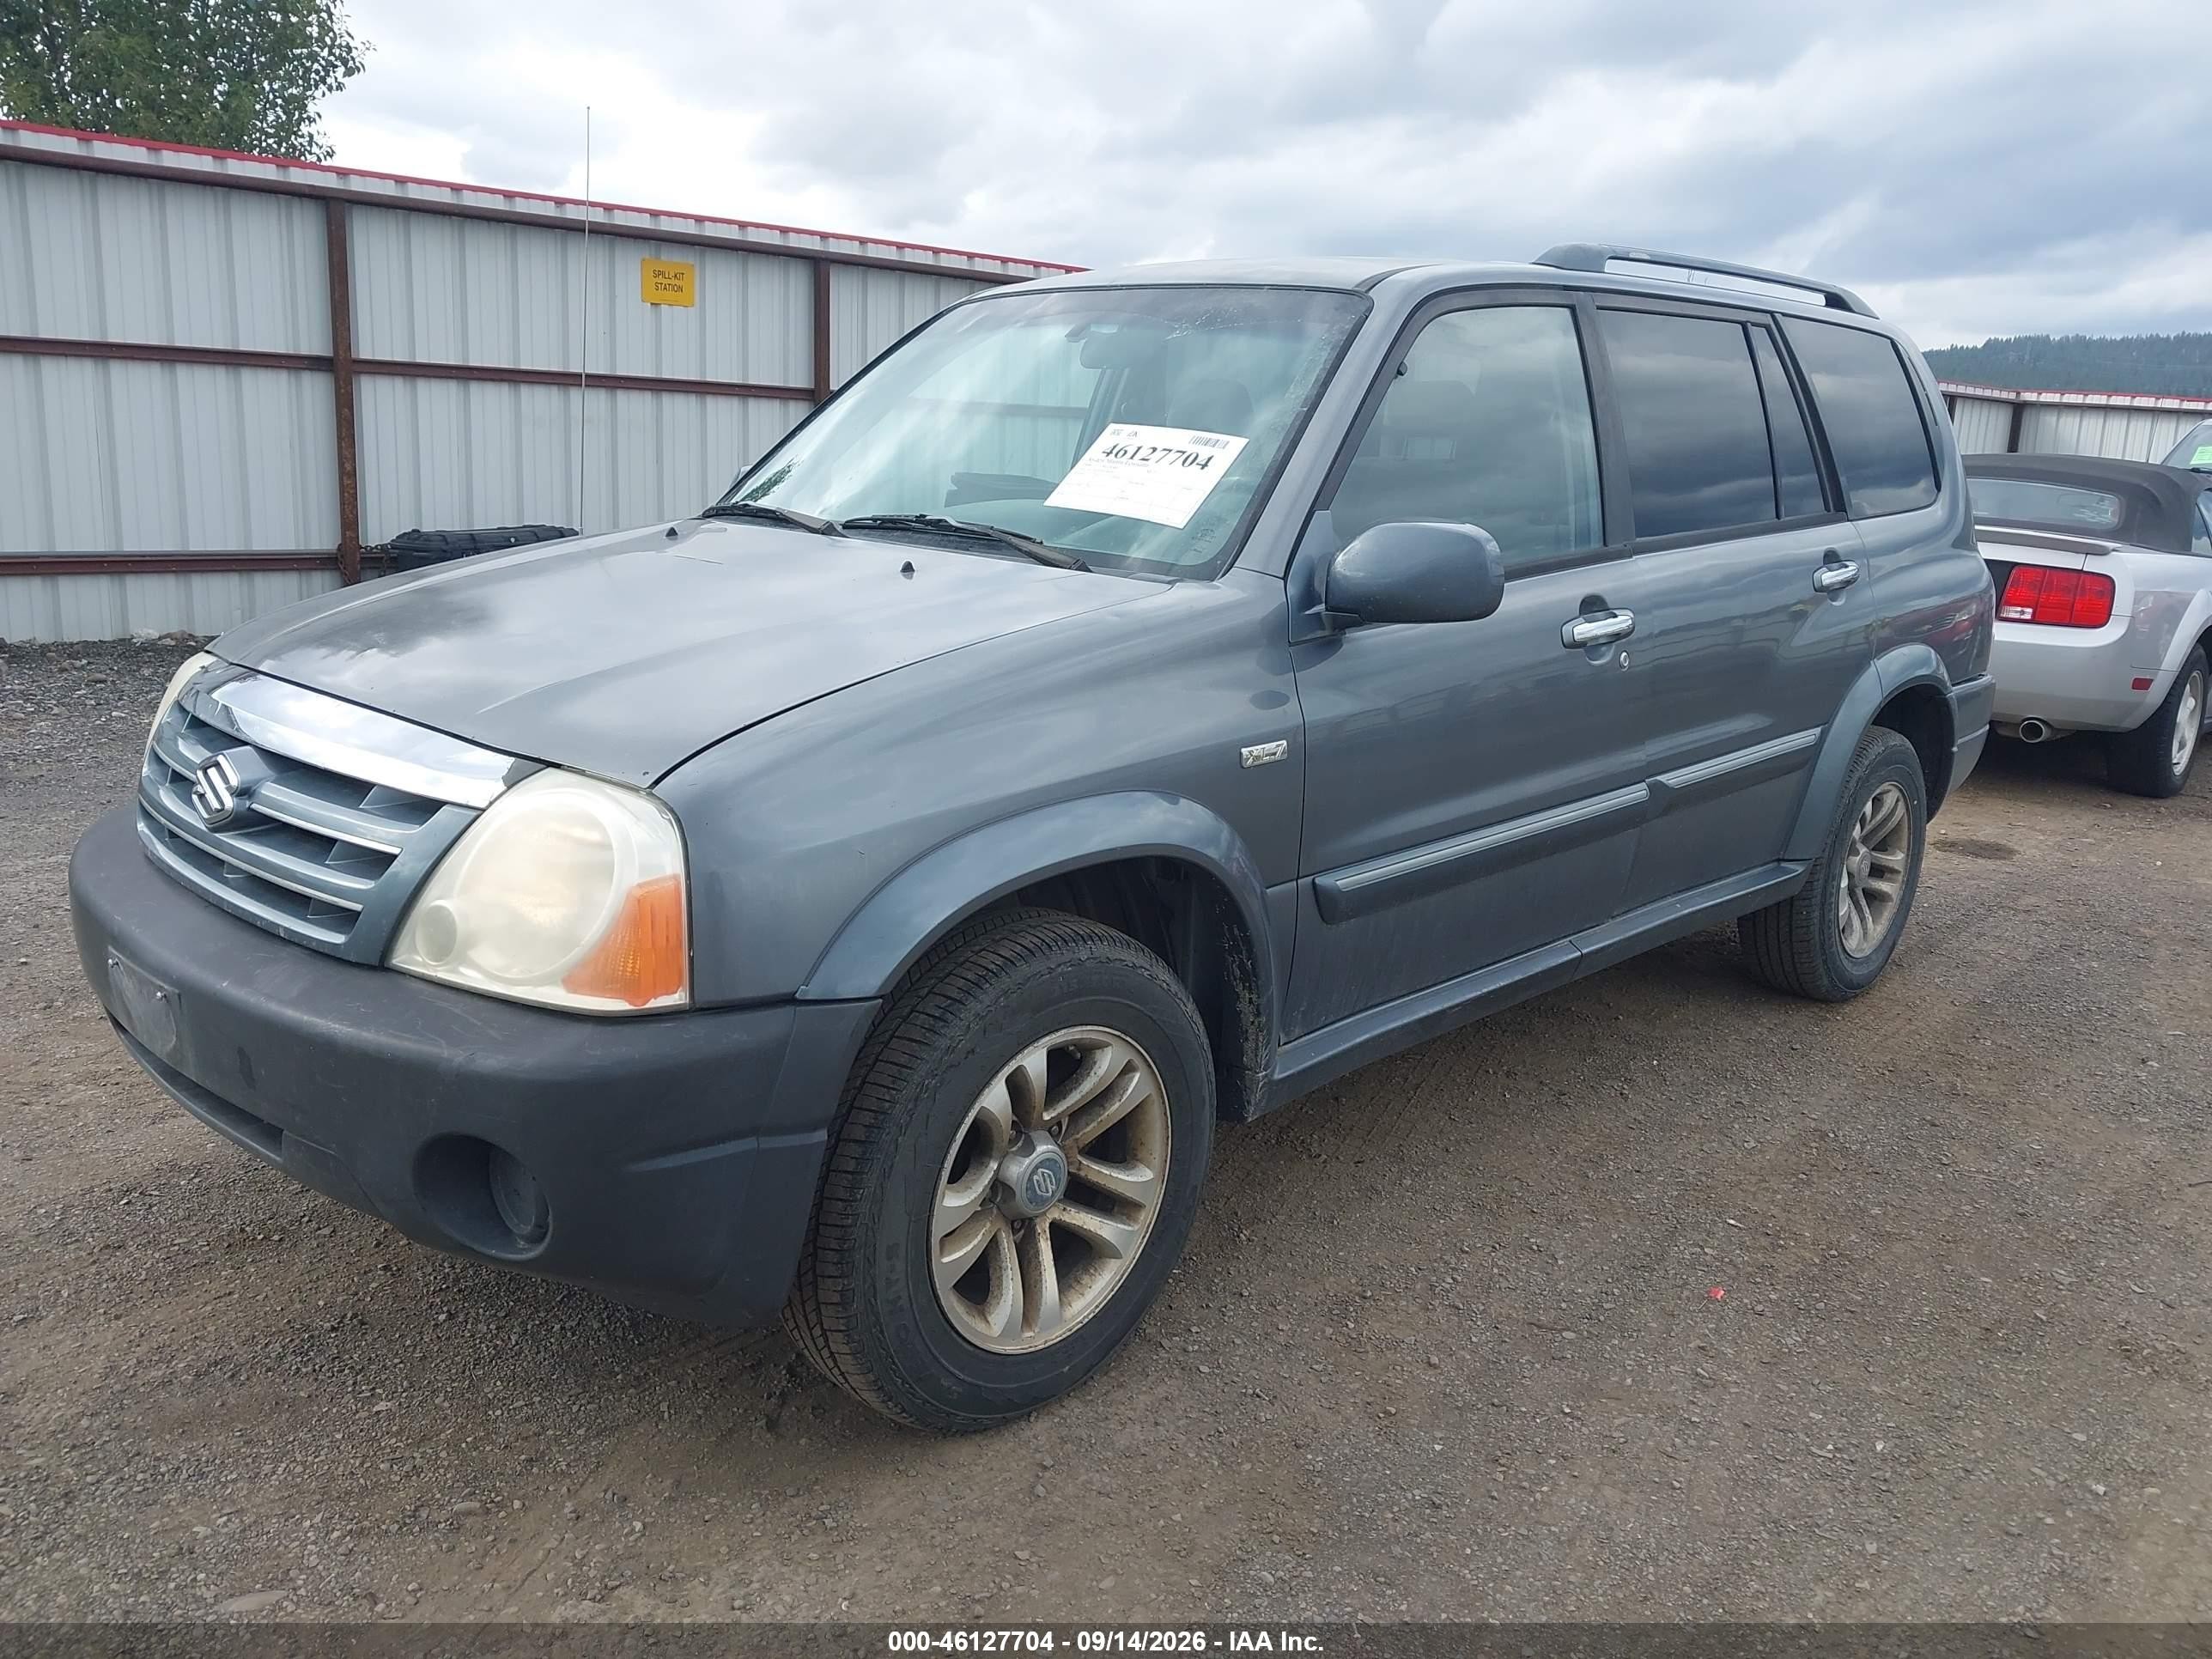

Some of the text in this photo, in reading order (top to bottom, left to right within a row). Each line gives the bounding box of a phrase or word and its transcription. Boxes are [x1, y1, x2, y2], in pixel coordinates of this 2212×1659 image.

[653, 269, 685, 281] SPILL-KIT
[654, 282, 684, 293] STATION
[1102, 443, 1214, 470] 46127704
